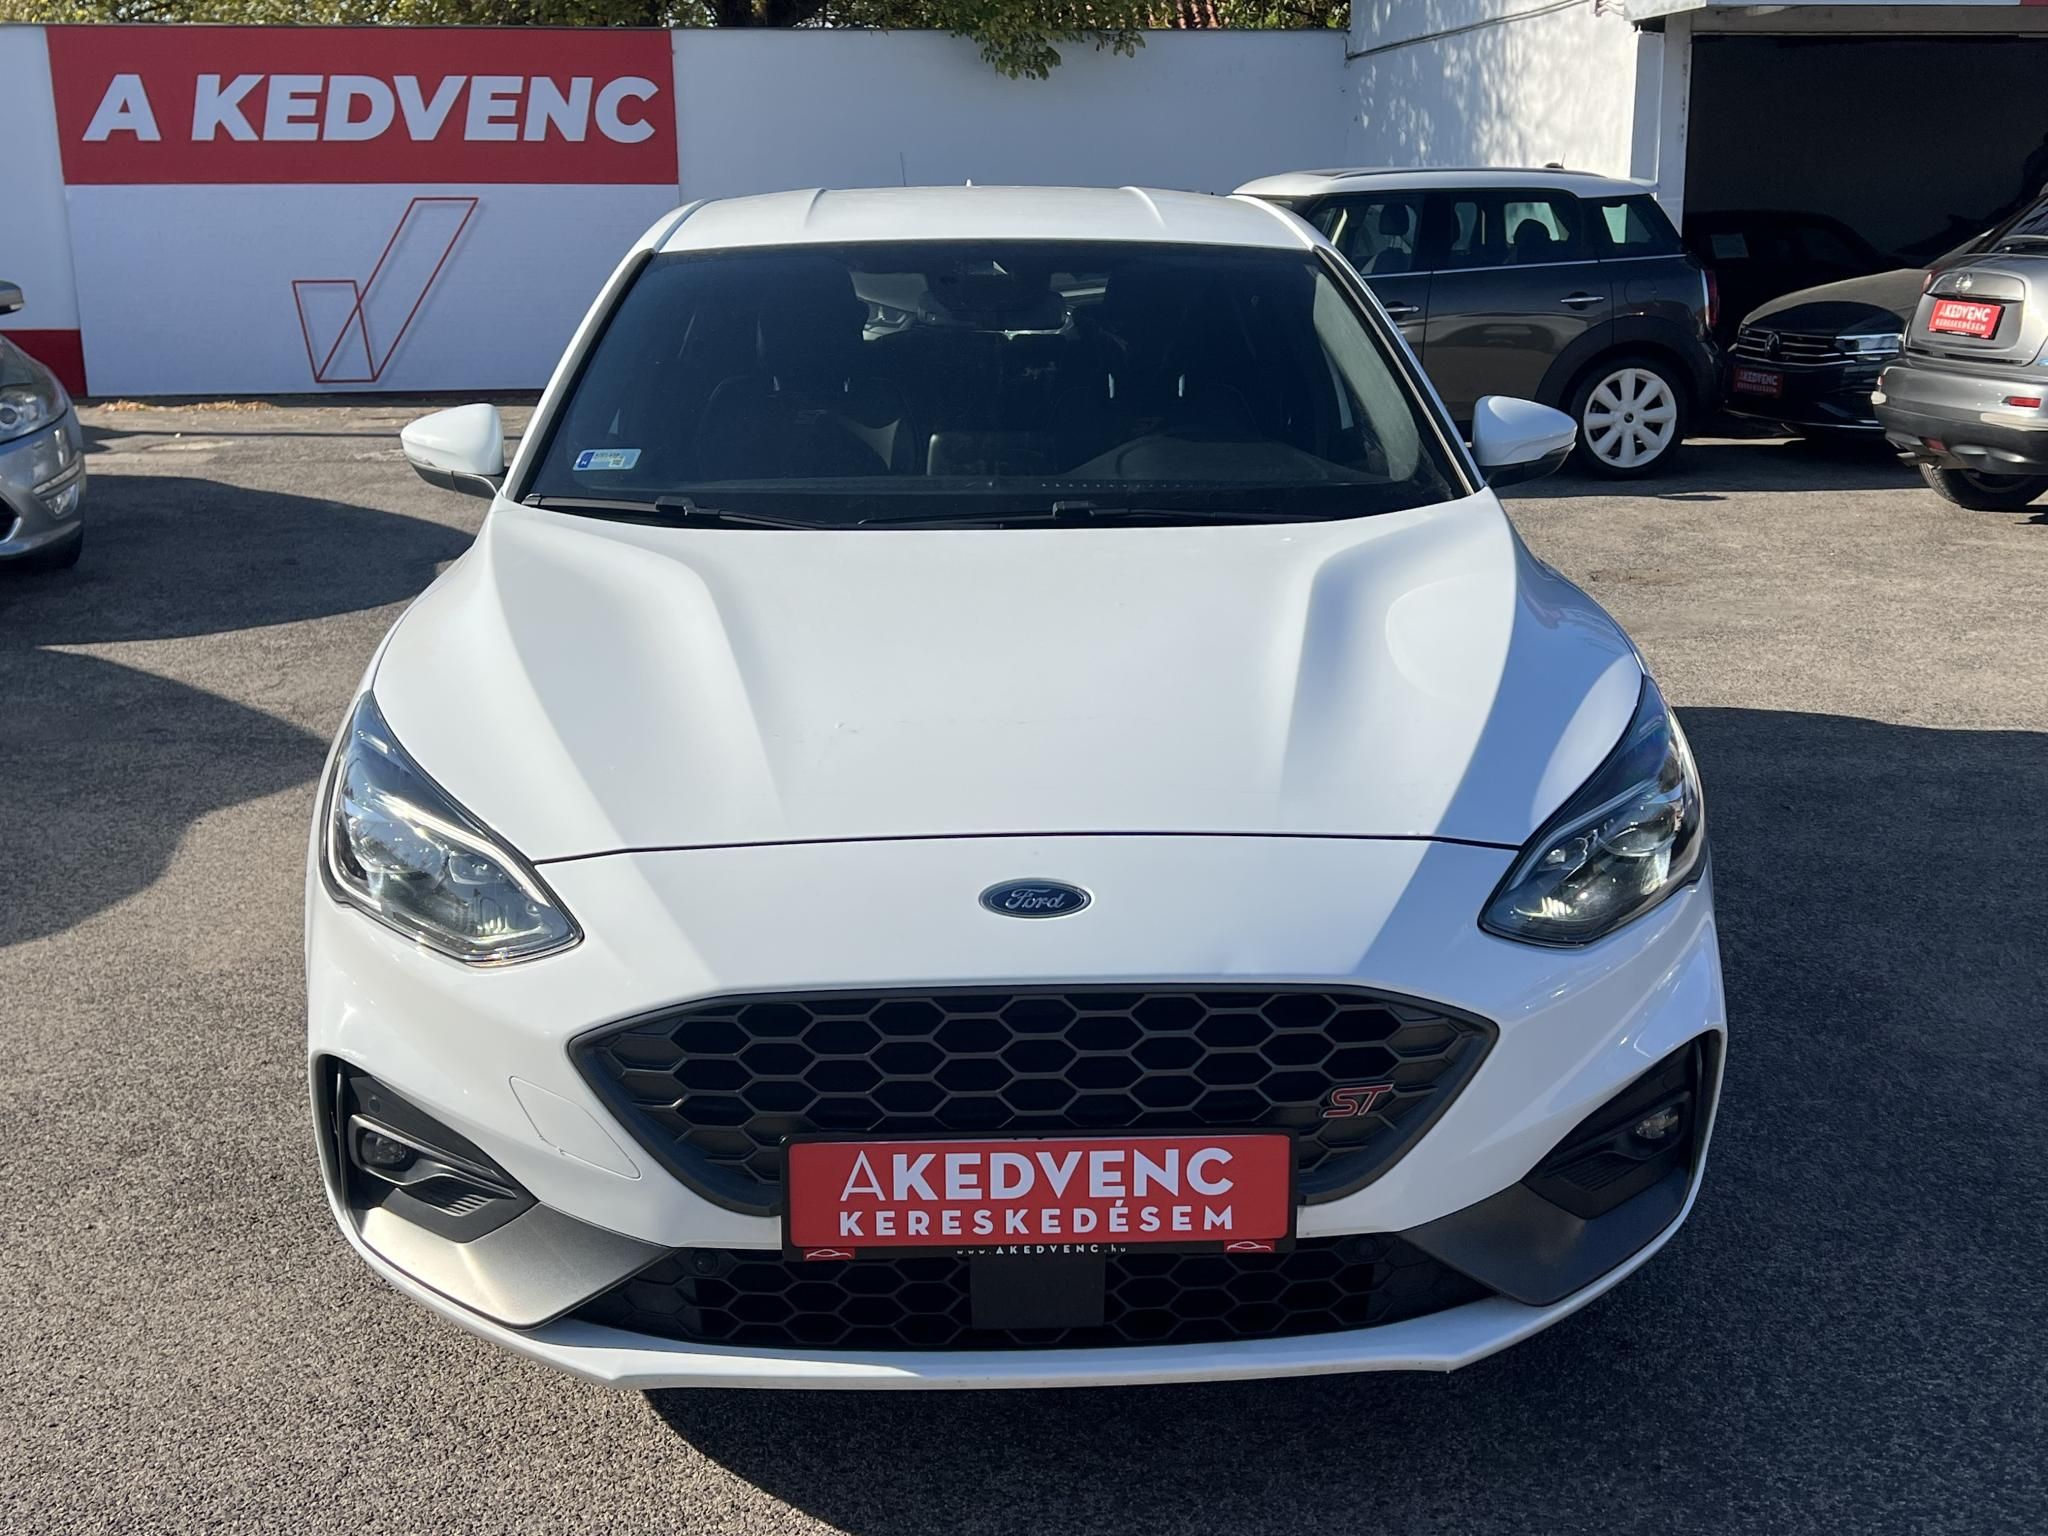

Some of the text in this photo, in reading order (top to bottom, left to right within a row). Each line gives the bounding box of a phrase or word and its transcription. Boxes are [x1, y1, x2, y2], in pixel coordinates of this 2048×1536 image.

[82, 74, 660, 144] A KEDVENC
[1005, 888, 1065, 909] Ford
[1322, 1083, 1394, 1118] ST
[839, 1200, 1233, 1237] KERESKEDÉSEM
